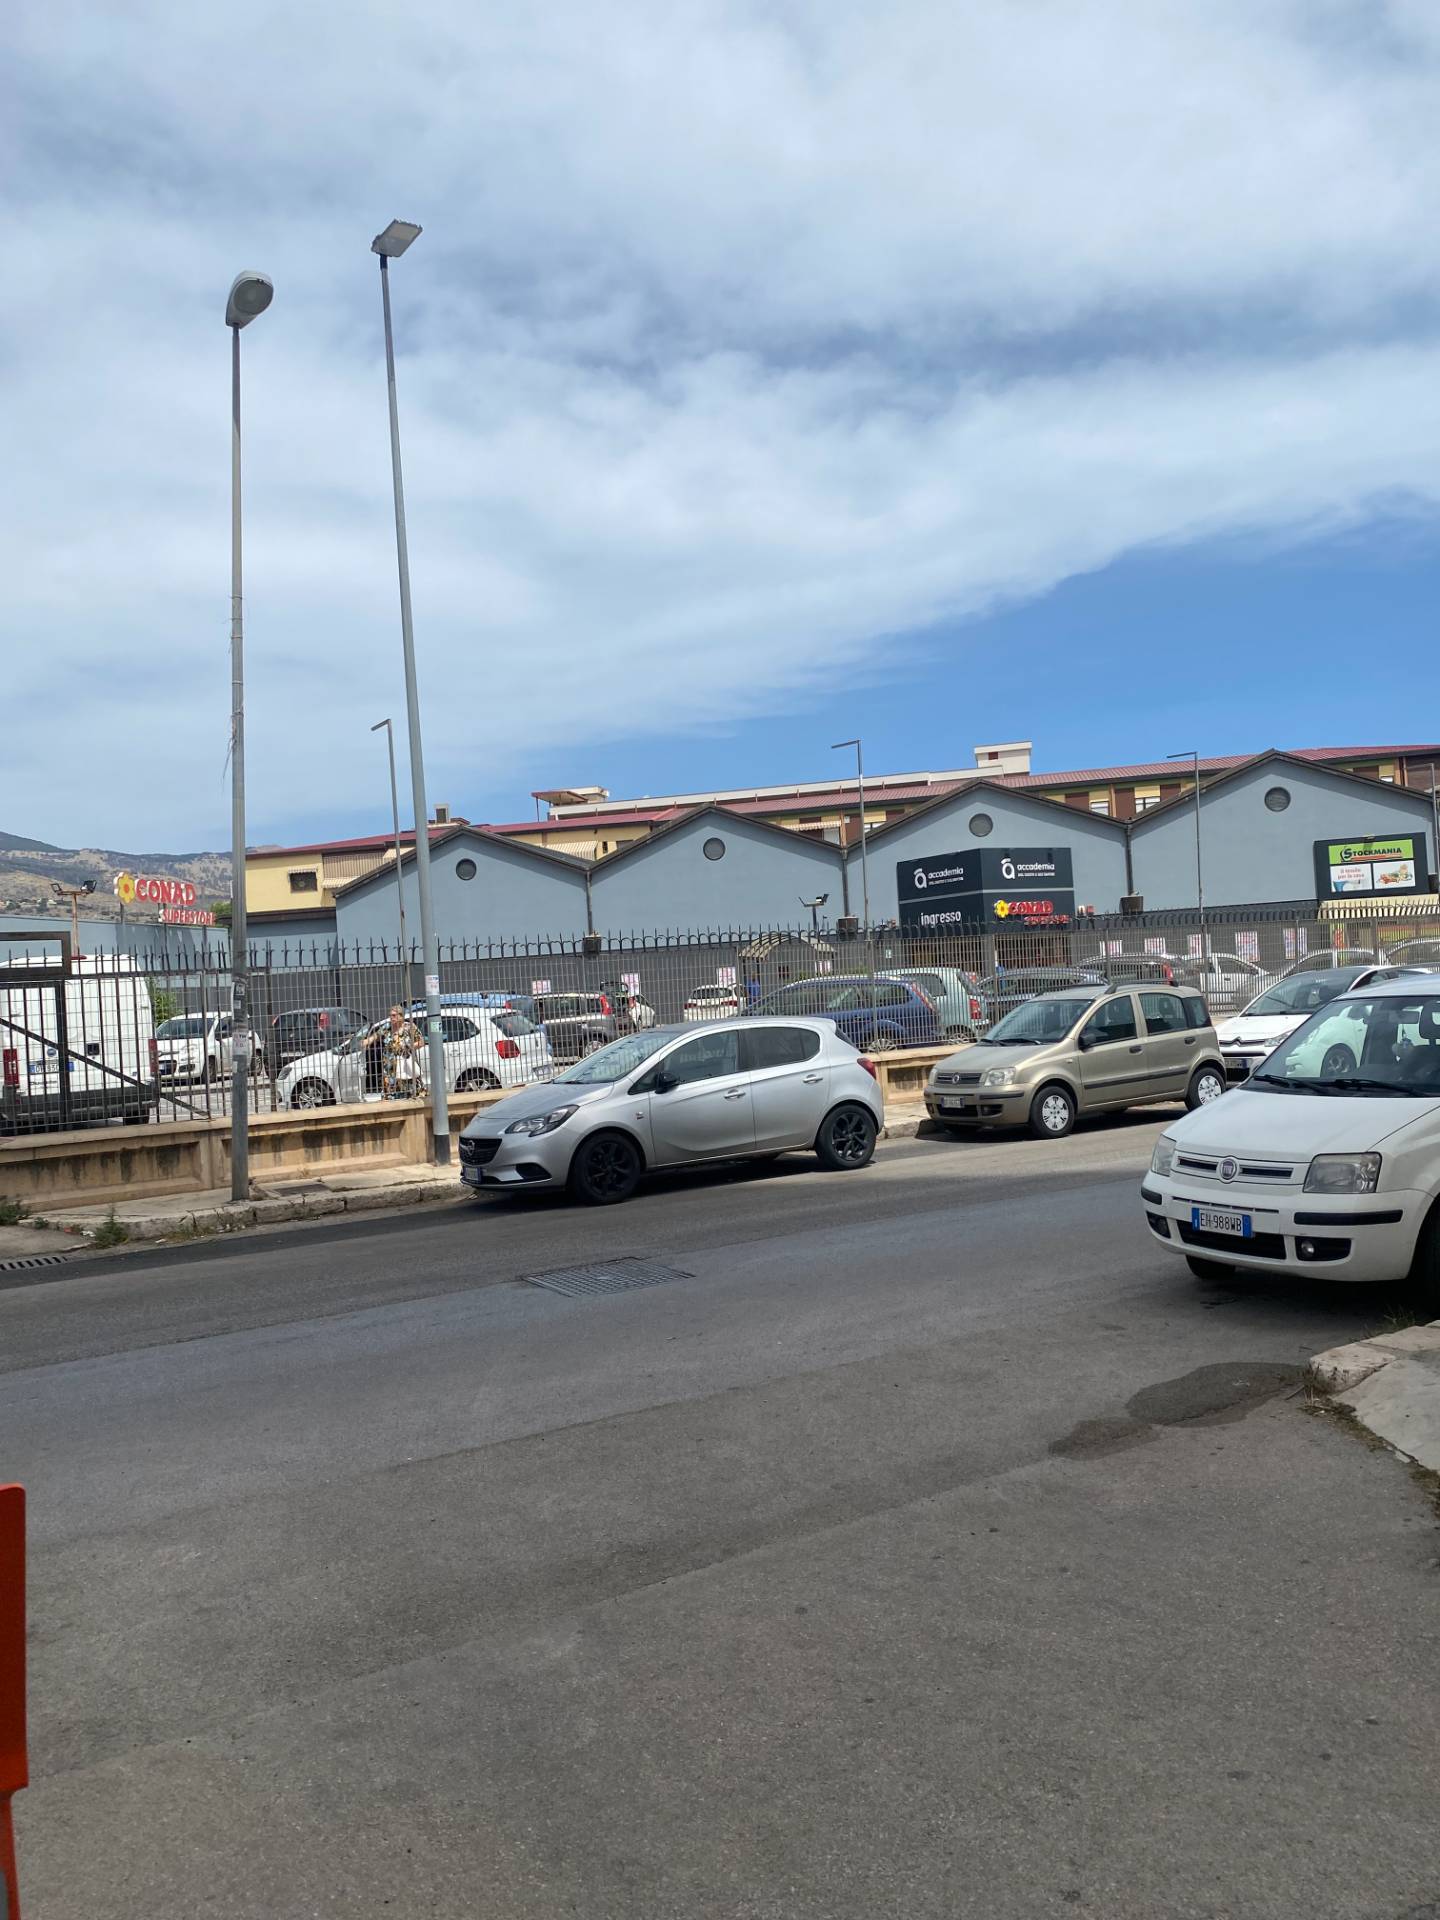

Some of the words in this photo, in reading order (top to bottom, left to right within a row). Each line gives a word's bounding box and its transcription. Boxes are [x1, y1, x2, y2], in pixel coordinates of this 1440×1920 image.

[928, 867, 964, 879] accademia
[1017, 863, 1055, 871] accademia
[135, 879, 196, 906] CONAD
[1008, 901, 1054, 915] CONAD
[920, 910, 962, 929] ingresso
